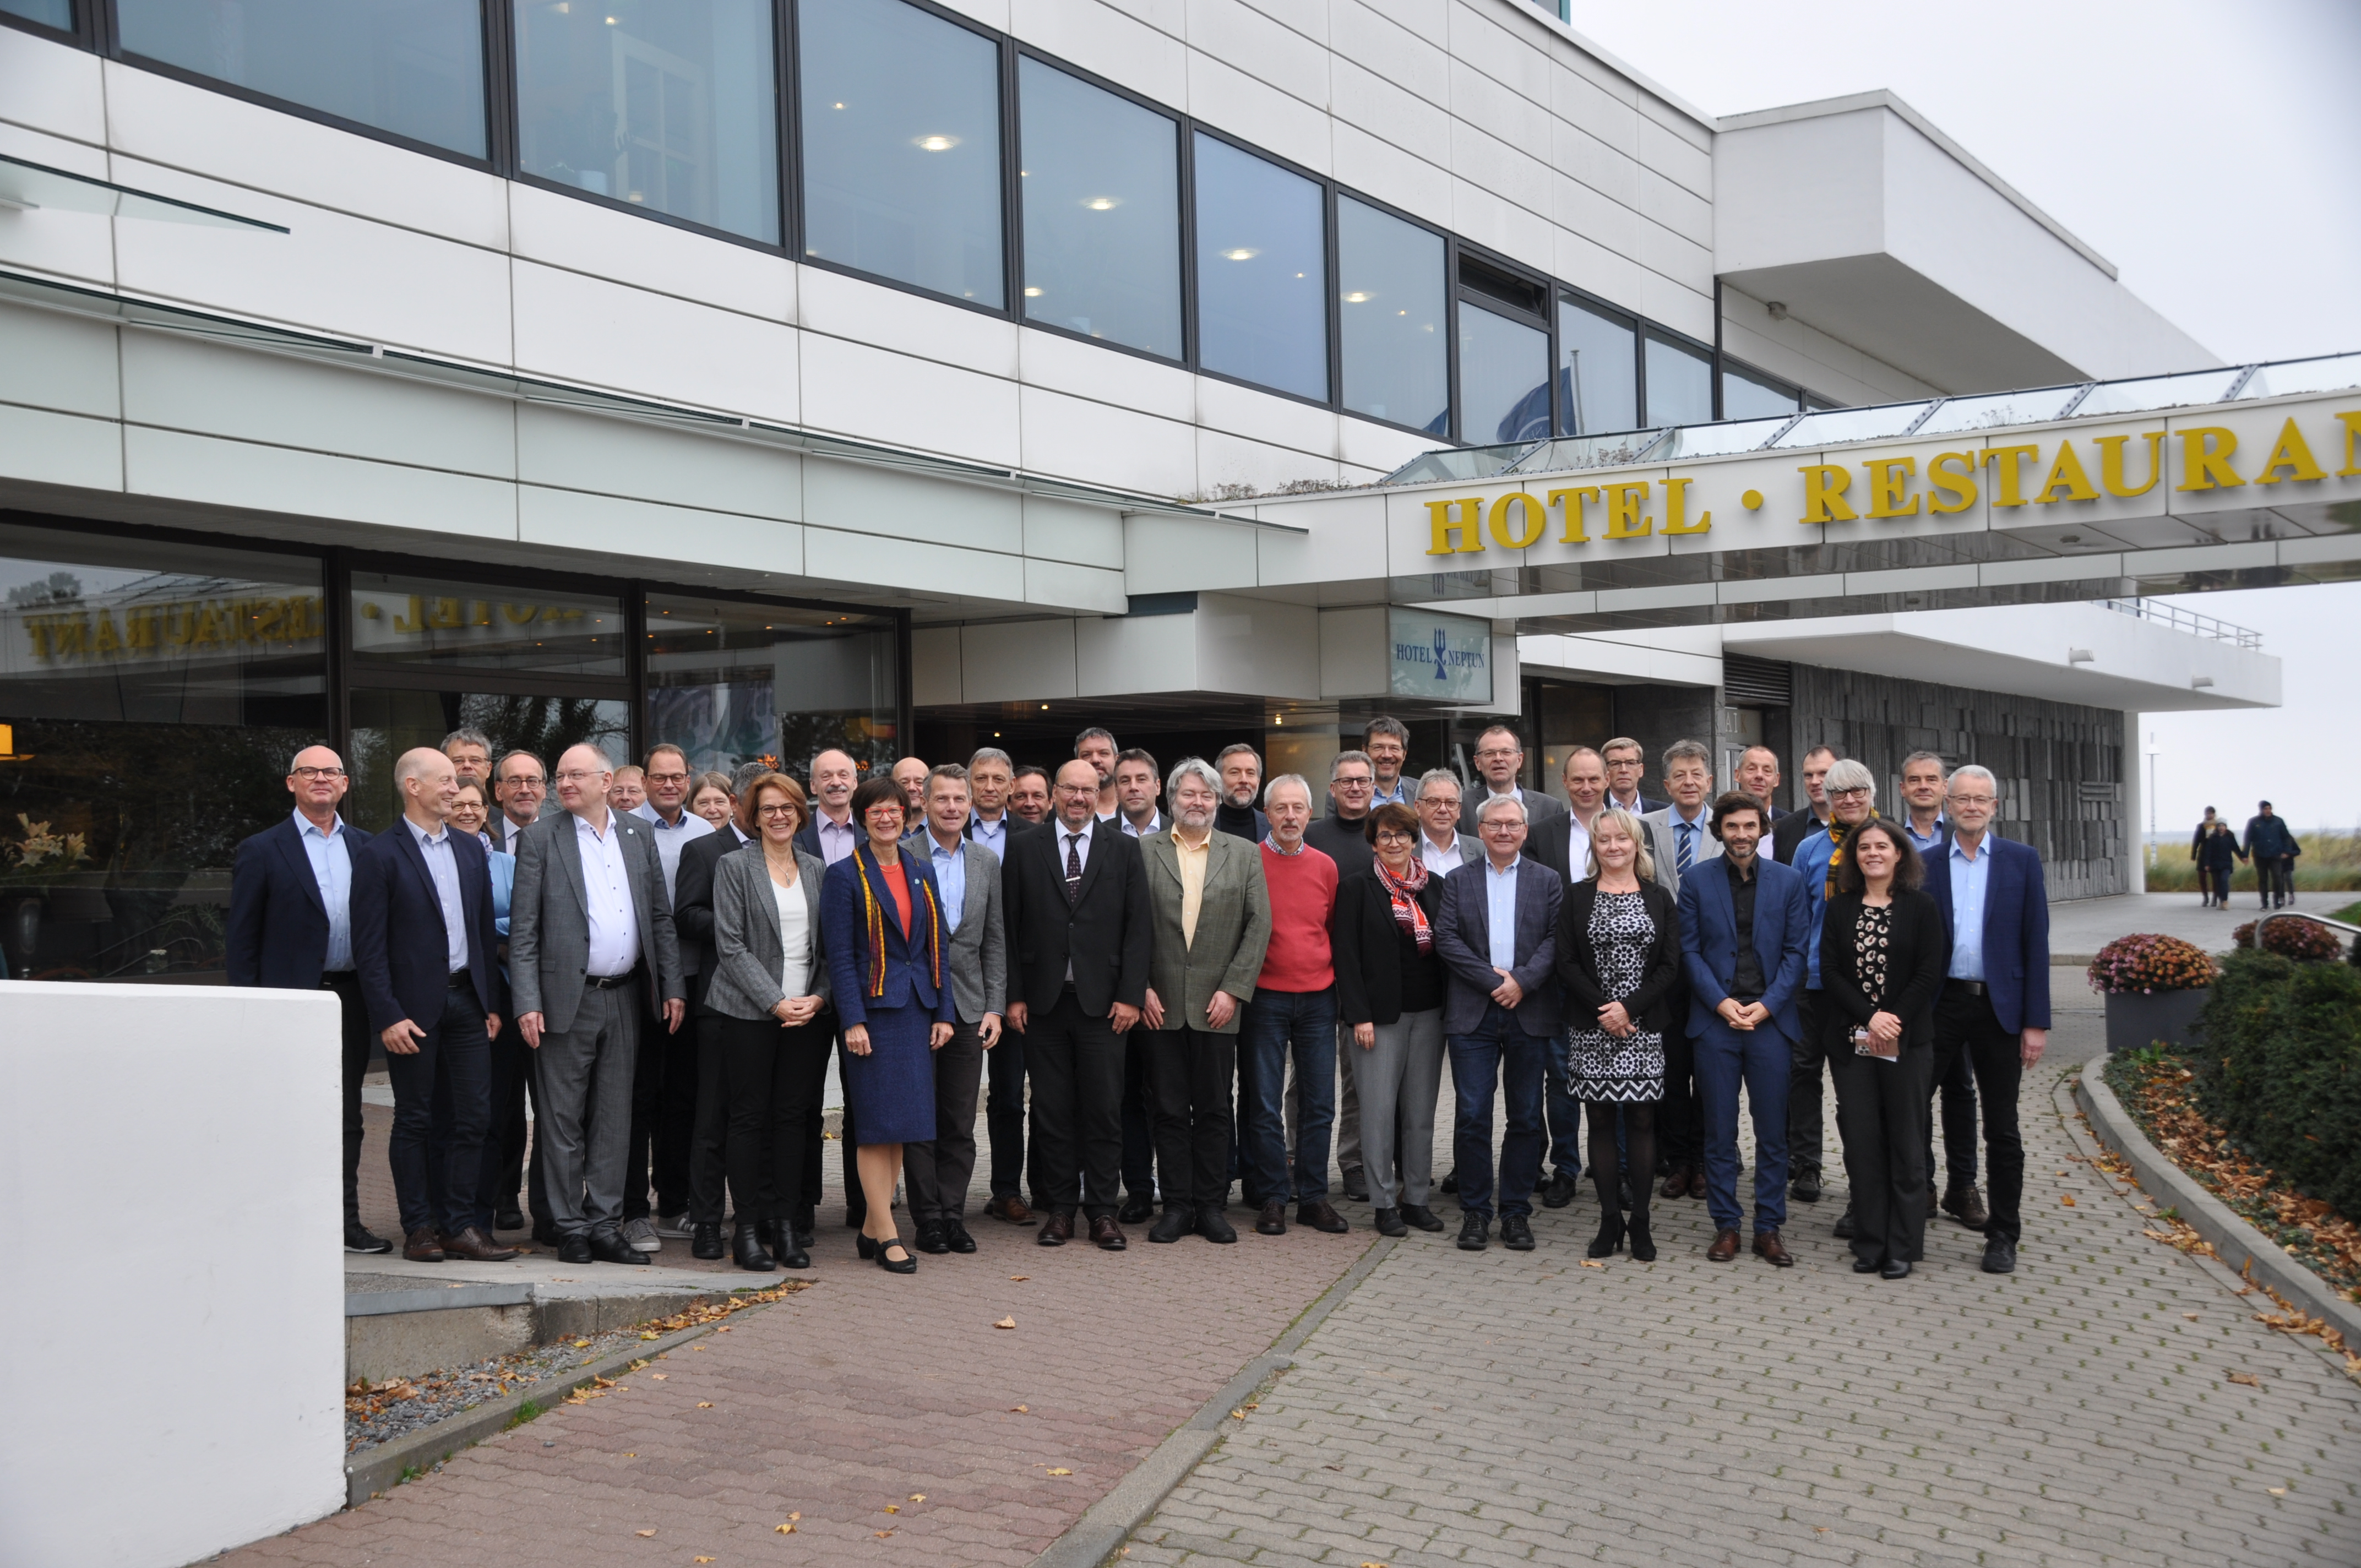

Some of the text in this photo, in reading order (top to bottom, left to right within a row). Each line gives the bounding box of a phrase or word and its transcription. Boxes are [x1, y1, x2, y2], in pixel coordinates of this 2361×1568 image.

[1424, 477, 1712, 556] HOTEL
[1396, 644, 1484, 668] HOTEL NEPTUN
